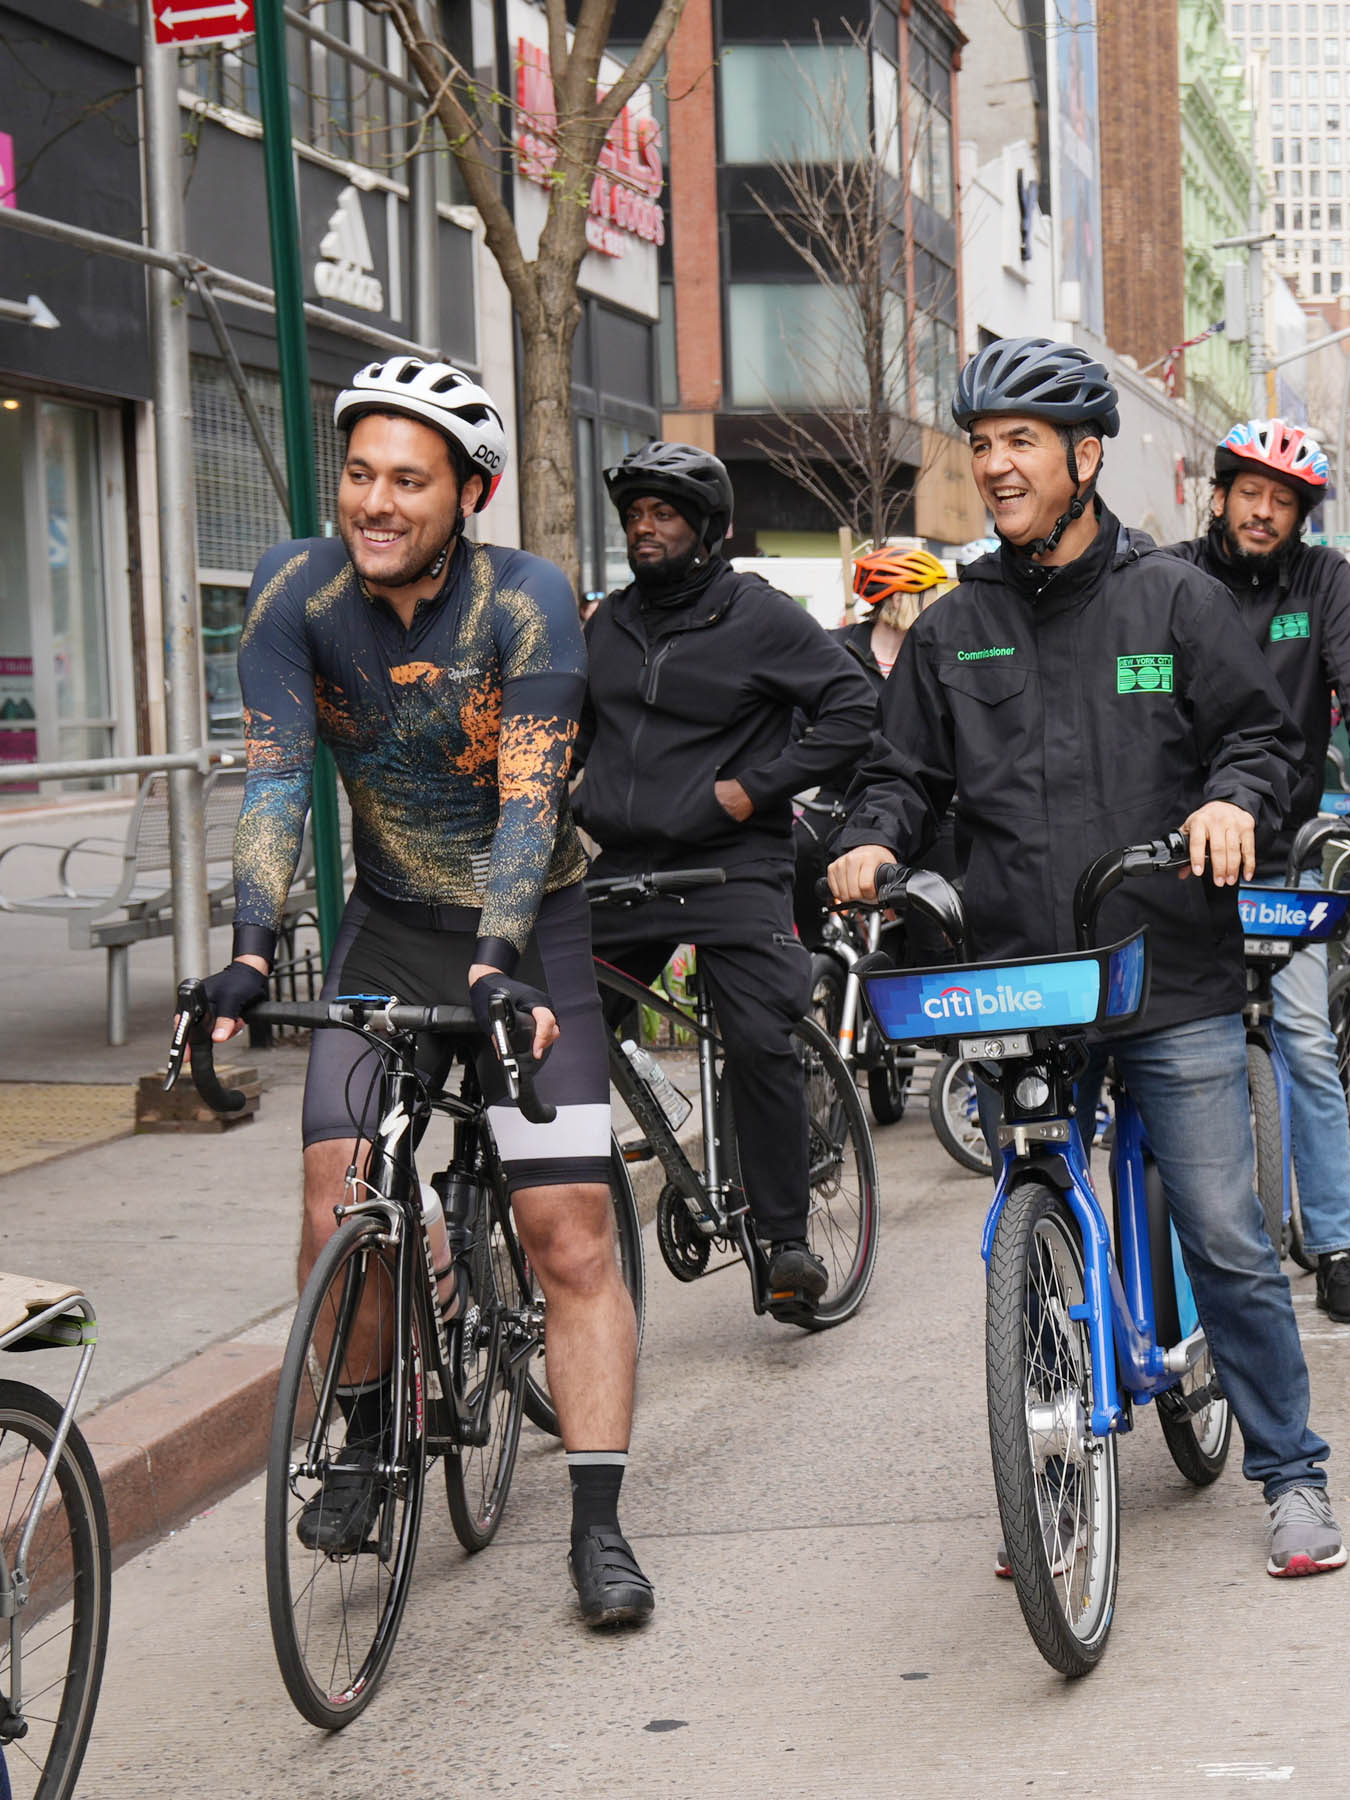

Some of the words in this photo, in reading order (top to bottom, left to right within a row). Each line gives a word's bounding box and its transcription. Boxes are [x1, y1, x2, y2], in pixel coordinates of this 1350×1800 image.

[957, 646, 1016, 661] Commissioner
[1136, 657, 1156, 665] YORK
[1258, 903, 1307, 925] bike
[924, 987, 974, 1019] citi
[975, 985, 1043, 1015] bike
